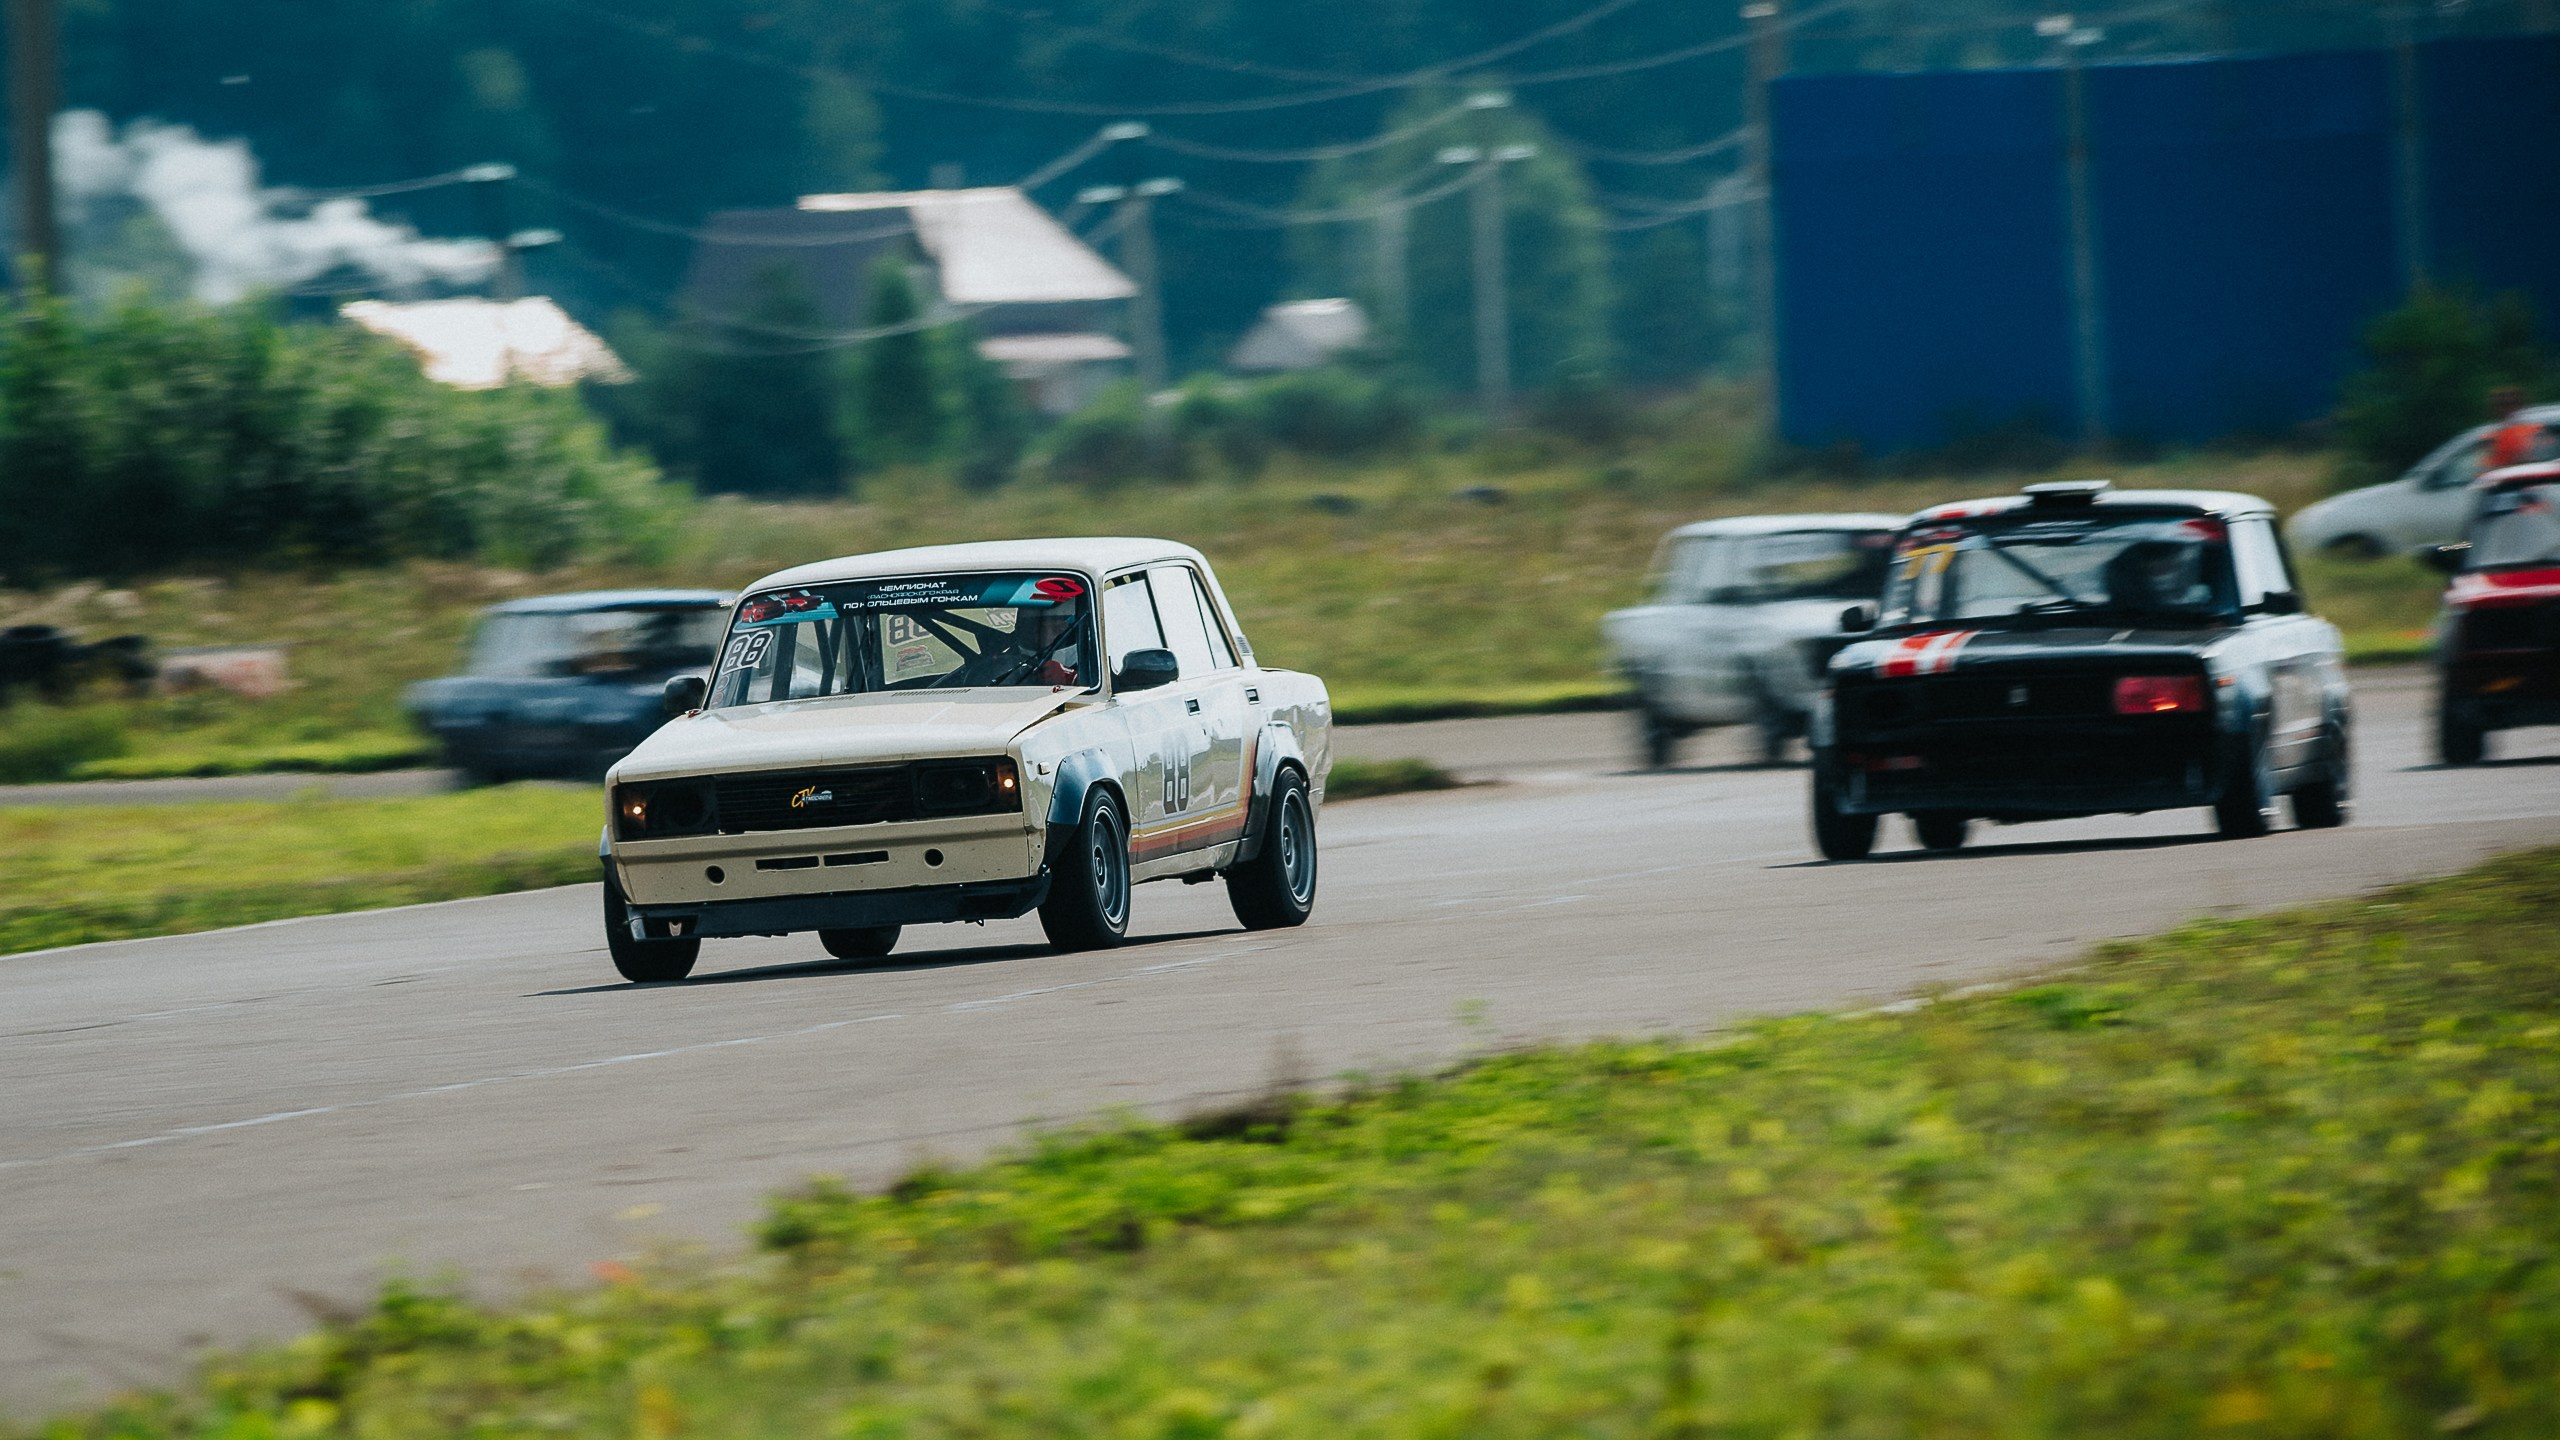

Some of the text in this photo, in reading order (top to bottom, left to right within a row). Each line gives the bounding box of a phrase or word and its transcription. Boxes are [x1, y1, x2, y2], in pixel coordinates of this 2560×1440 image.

[879, 582, 947, 592] ЧЕМПИОНАТ
[843, 602, 858, 610] ПО
[931, 595, 979, 603] ГОНКАМ
[721, 631, 773, 674] 88
[1161, 736, 1191, 815] 88
